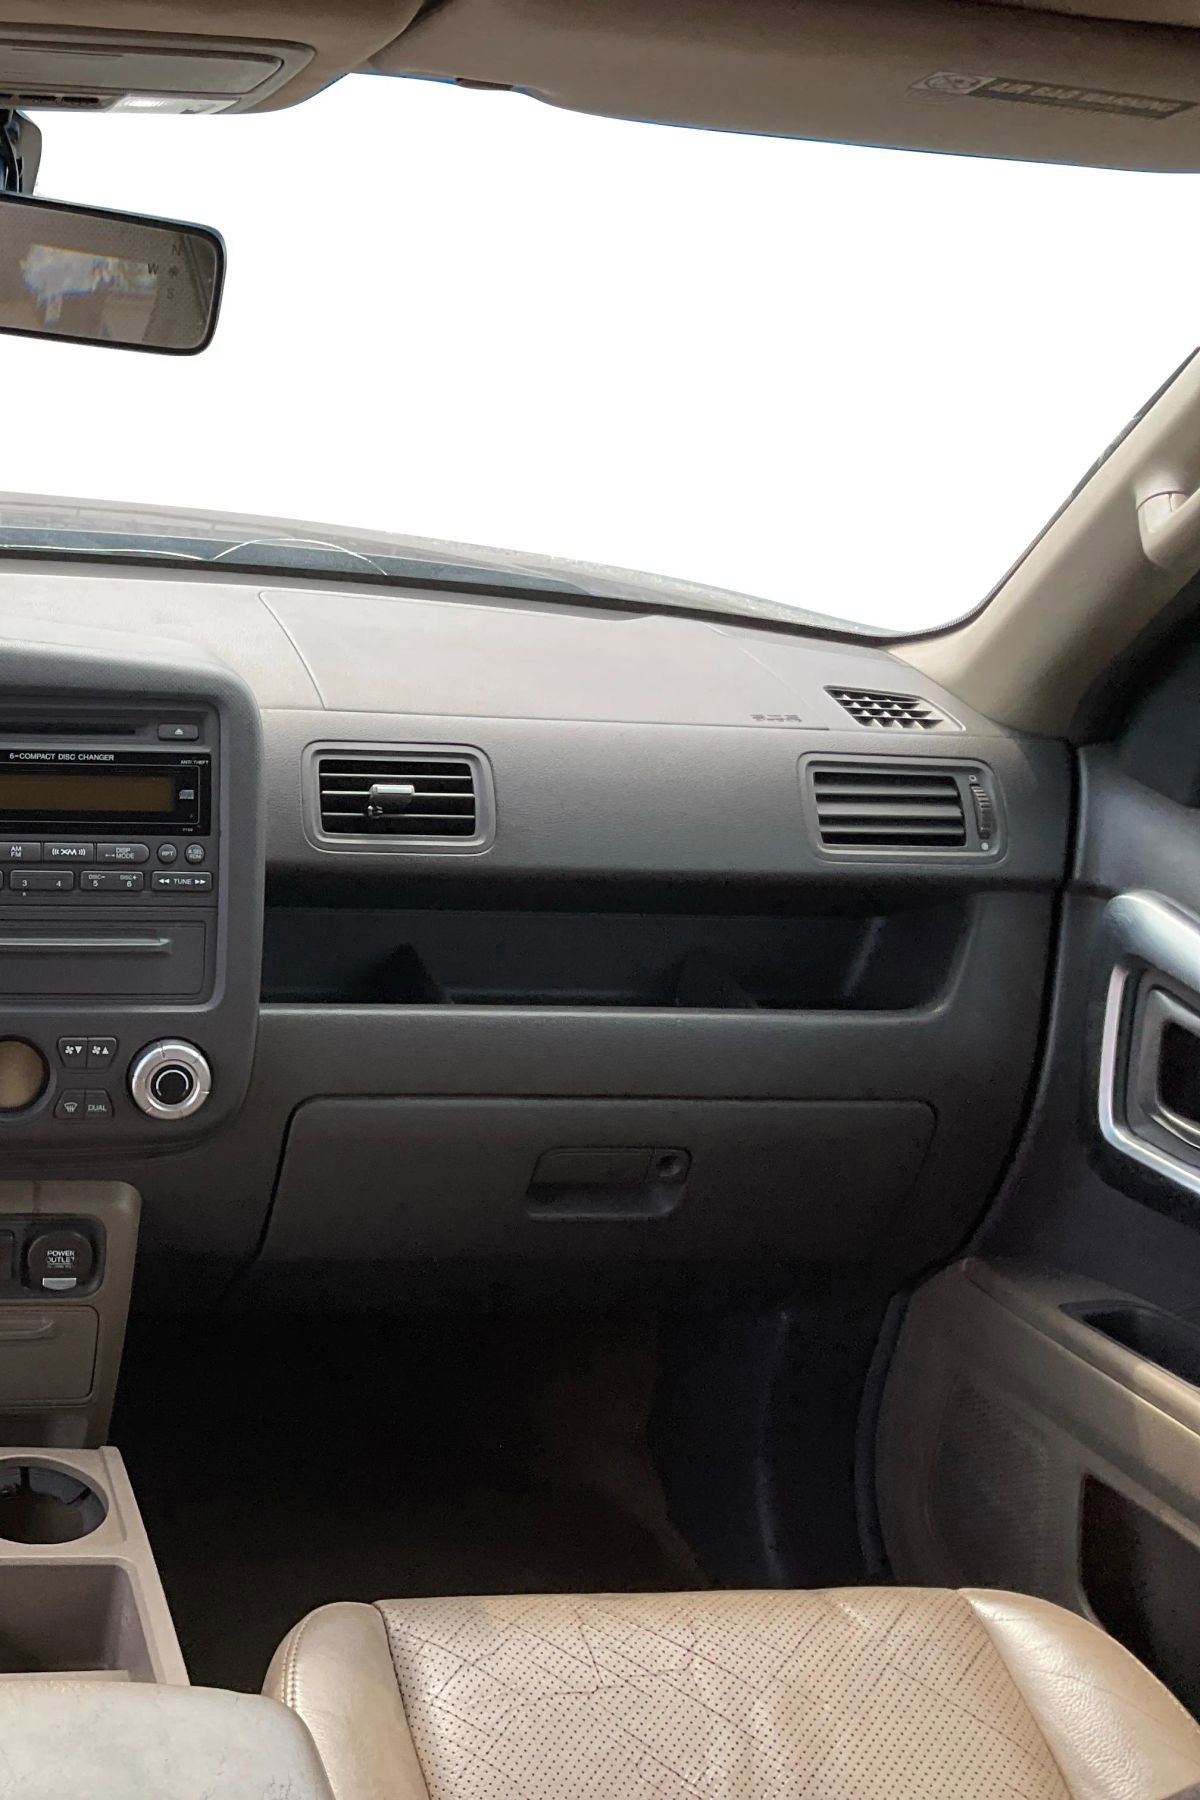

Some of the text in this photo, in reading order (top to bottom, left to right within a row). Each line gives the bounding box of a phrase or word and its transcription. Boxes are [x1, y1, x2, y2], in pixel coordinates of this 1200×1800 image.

[148, 263, 160, 275] W
[9, 753, 56, 761] 6-COMPACT
[78, 754, 115, 762] CHANGER
[126, 880, 133, 888] 6
[87, 1104, 107, 1112] DUAL
